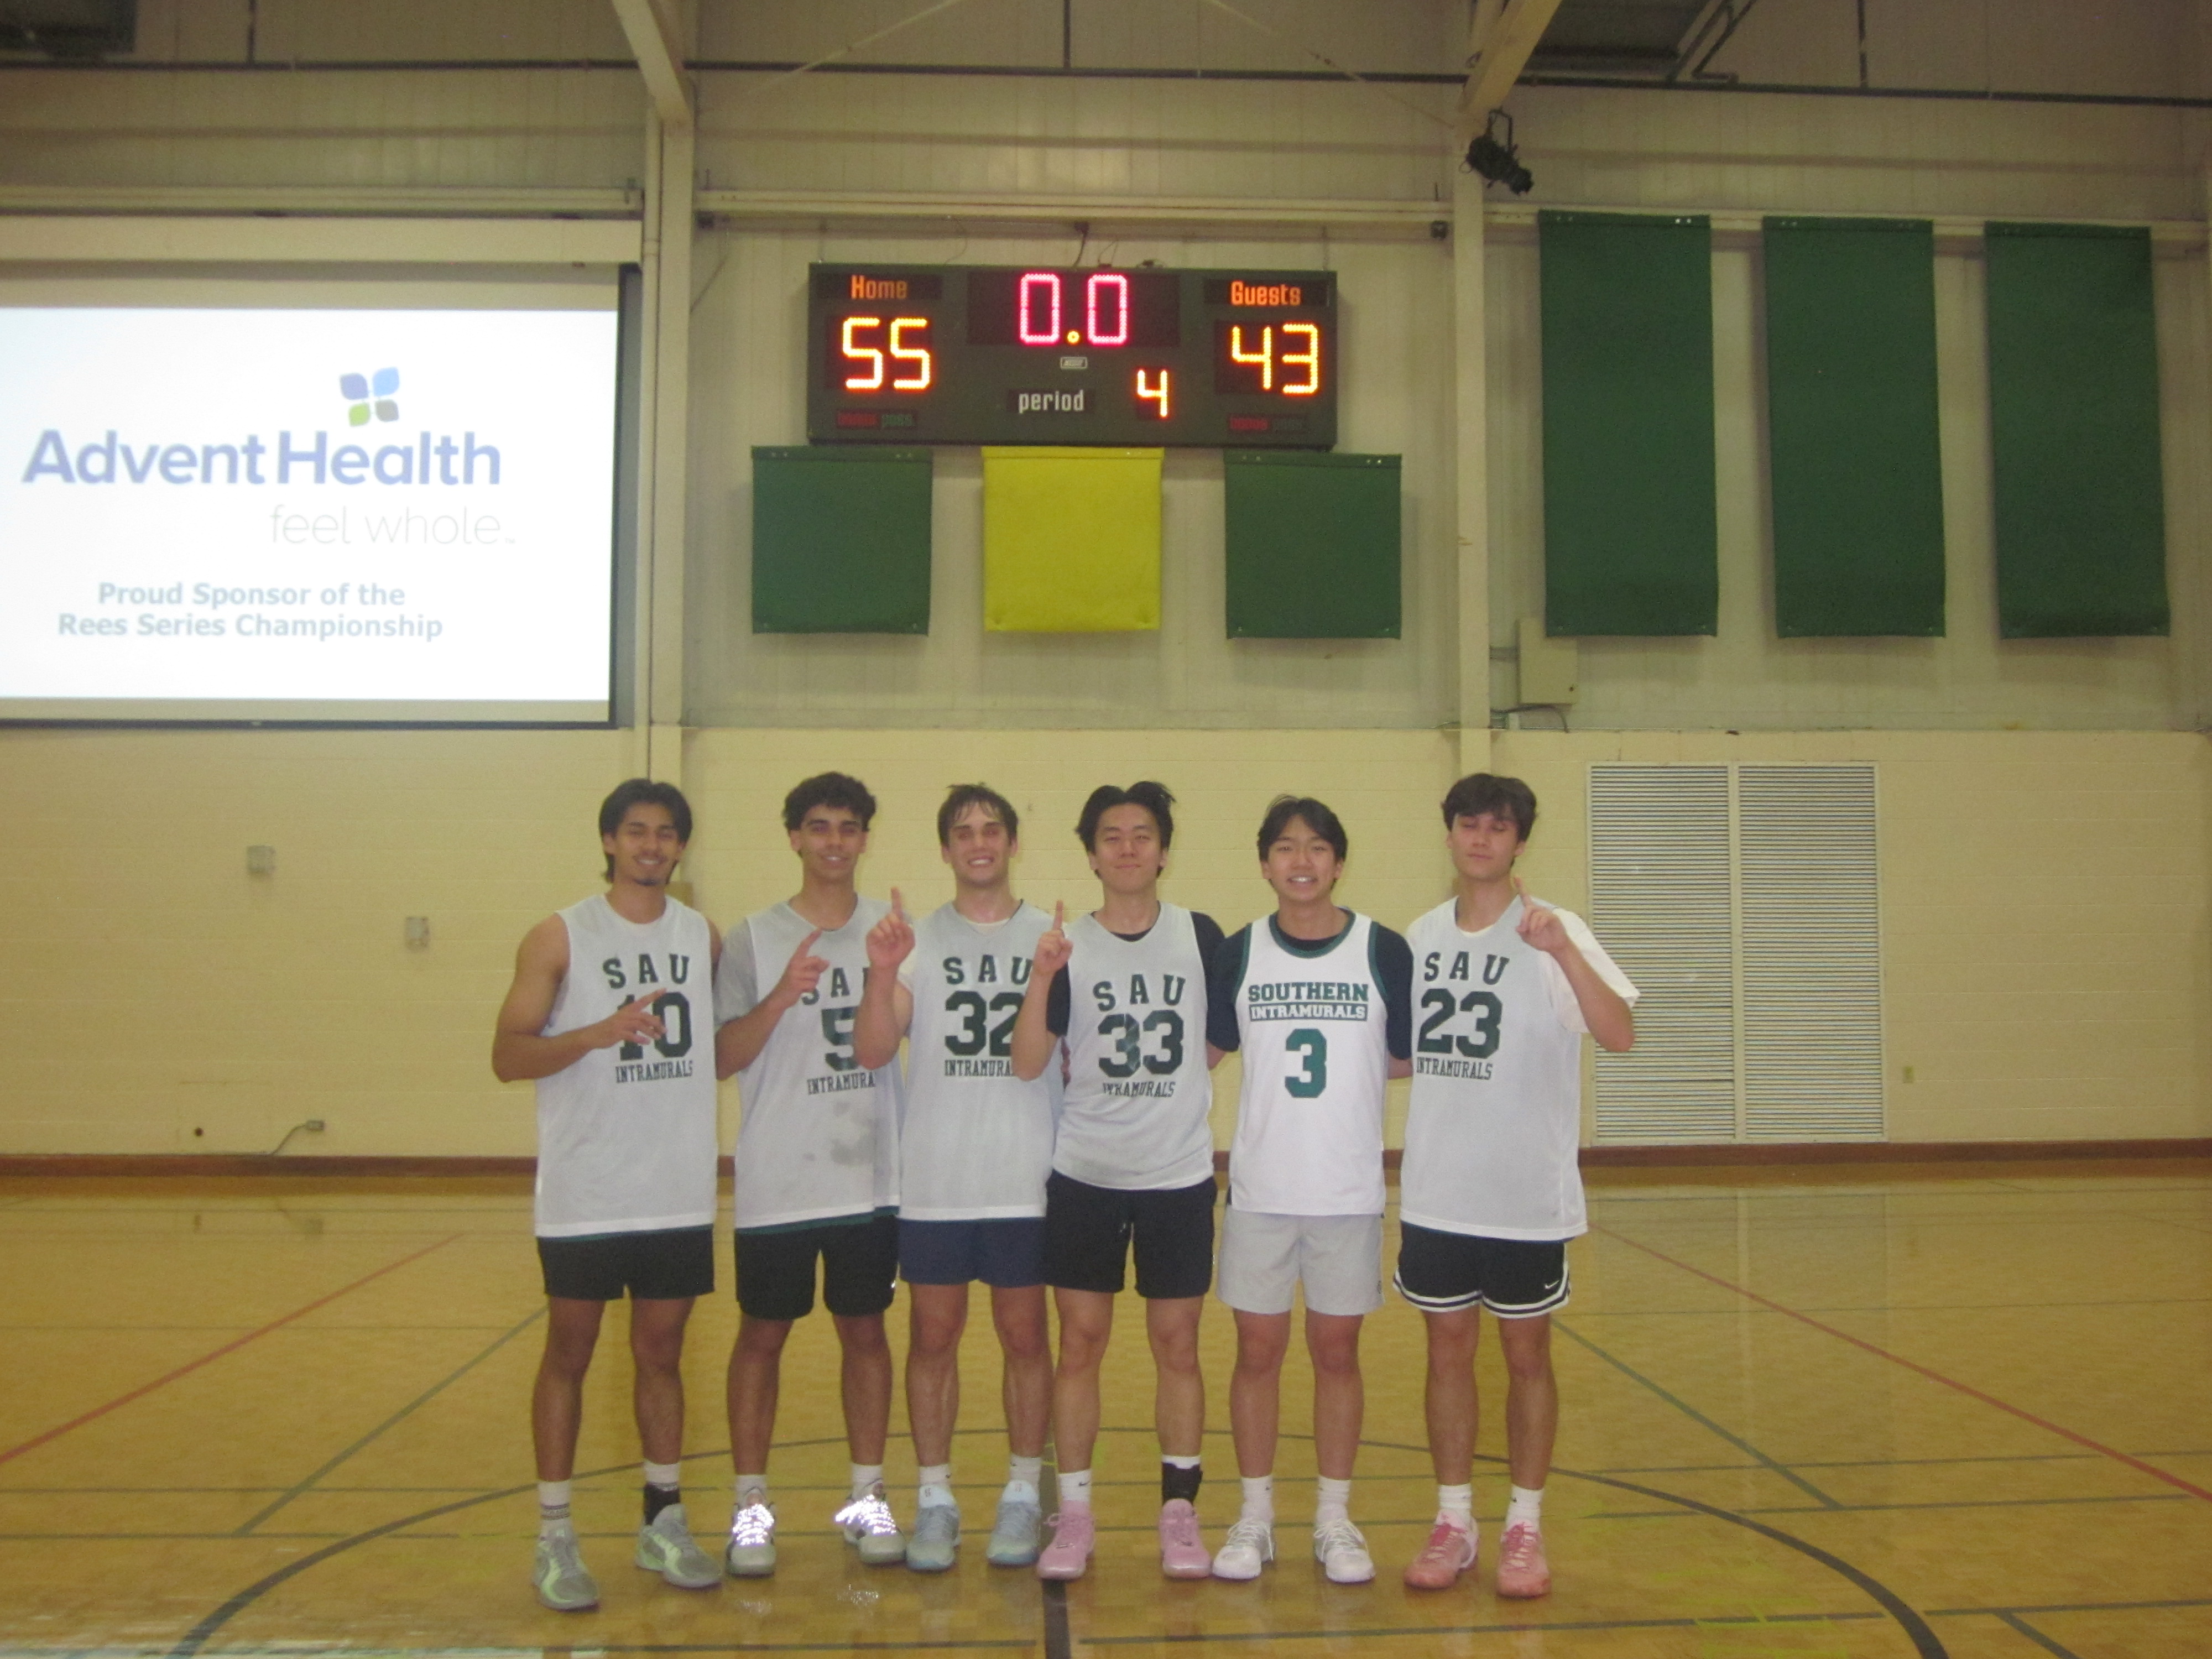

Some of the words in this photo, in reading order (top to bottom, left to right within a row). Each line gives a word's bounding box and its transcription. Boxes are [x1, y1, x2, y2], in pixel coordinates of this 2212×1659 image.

[851, 275, 907, 299] Home
[1231, 280, 1301, 305] Guests
[1020, 273, 1127, 345] 0.0
[843, 317, 930, 389] 55
[1232, 324, 1318, 394] 43
[1018, 389, 1084, 414] period
[1138, 369, 1167, 417] 4
[22, 429, 500, 486] AdventHealth
[270, 504, 351, 544] feel
[97, 581, 184, 606] Proud
[192, 582, 311, 610] Sponsor
[320, 582, 349, 606] of
[357, 582, 405, 606] the
[57, 612, 128, 636] Rees
[136, 612, 226, 636] Series
[235, 613, 443, 642] Championship
[1248, 982, 1368, 1002] SOUTHERN
[945, 990, 1024, 1056] 32
[1250, 1004, 1366, 1020] INTRAMURALS
[1417, 988, 1503, 1058] 23
[1098, 1010, 1184, 1077] 33
[615, 1061, 693, 1083] INTRAMURALS
[1285, 1029, 1327, 1098] 3
[1417, 1057, 1493, 1080] INTRAMURALS
[807, 1072, 876, 1095] INTRAMURA
